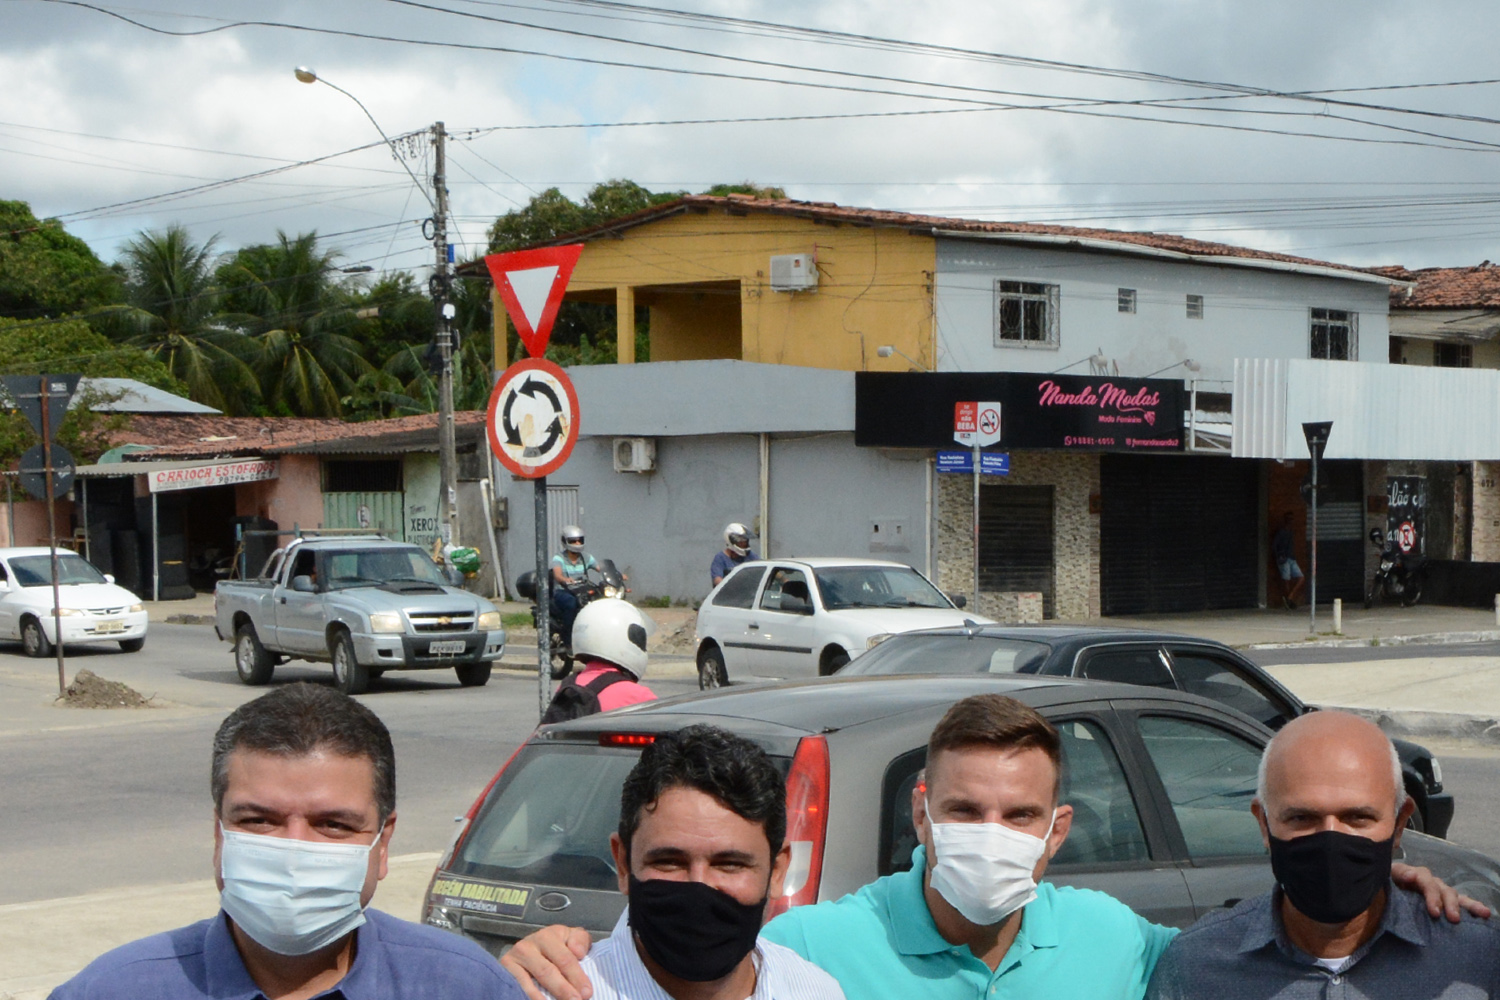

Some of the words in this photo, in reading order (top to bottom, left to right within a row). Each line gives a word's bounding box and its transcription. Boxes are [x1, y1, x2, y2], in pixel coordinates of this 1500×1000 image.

[1038, 380, 1098, 406] Nanda
[1098, 382, 1160, 409] Modas
[957, 422, 976, 430] BEBA
[156, 467, 212, 483] CARIOCA
[215, 461, 276, 477] ESTOFADOS
[411, 518, 440, 532] XEROX
[432, 879, 463, 896] RECÉM
[460, 883, 529, 906] HABILITADA
[463, 900, 498, 913] PACIÊNCIA
